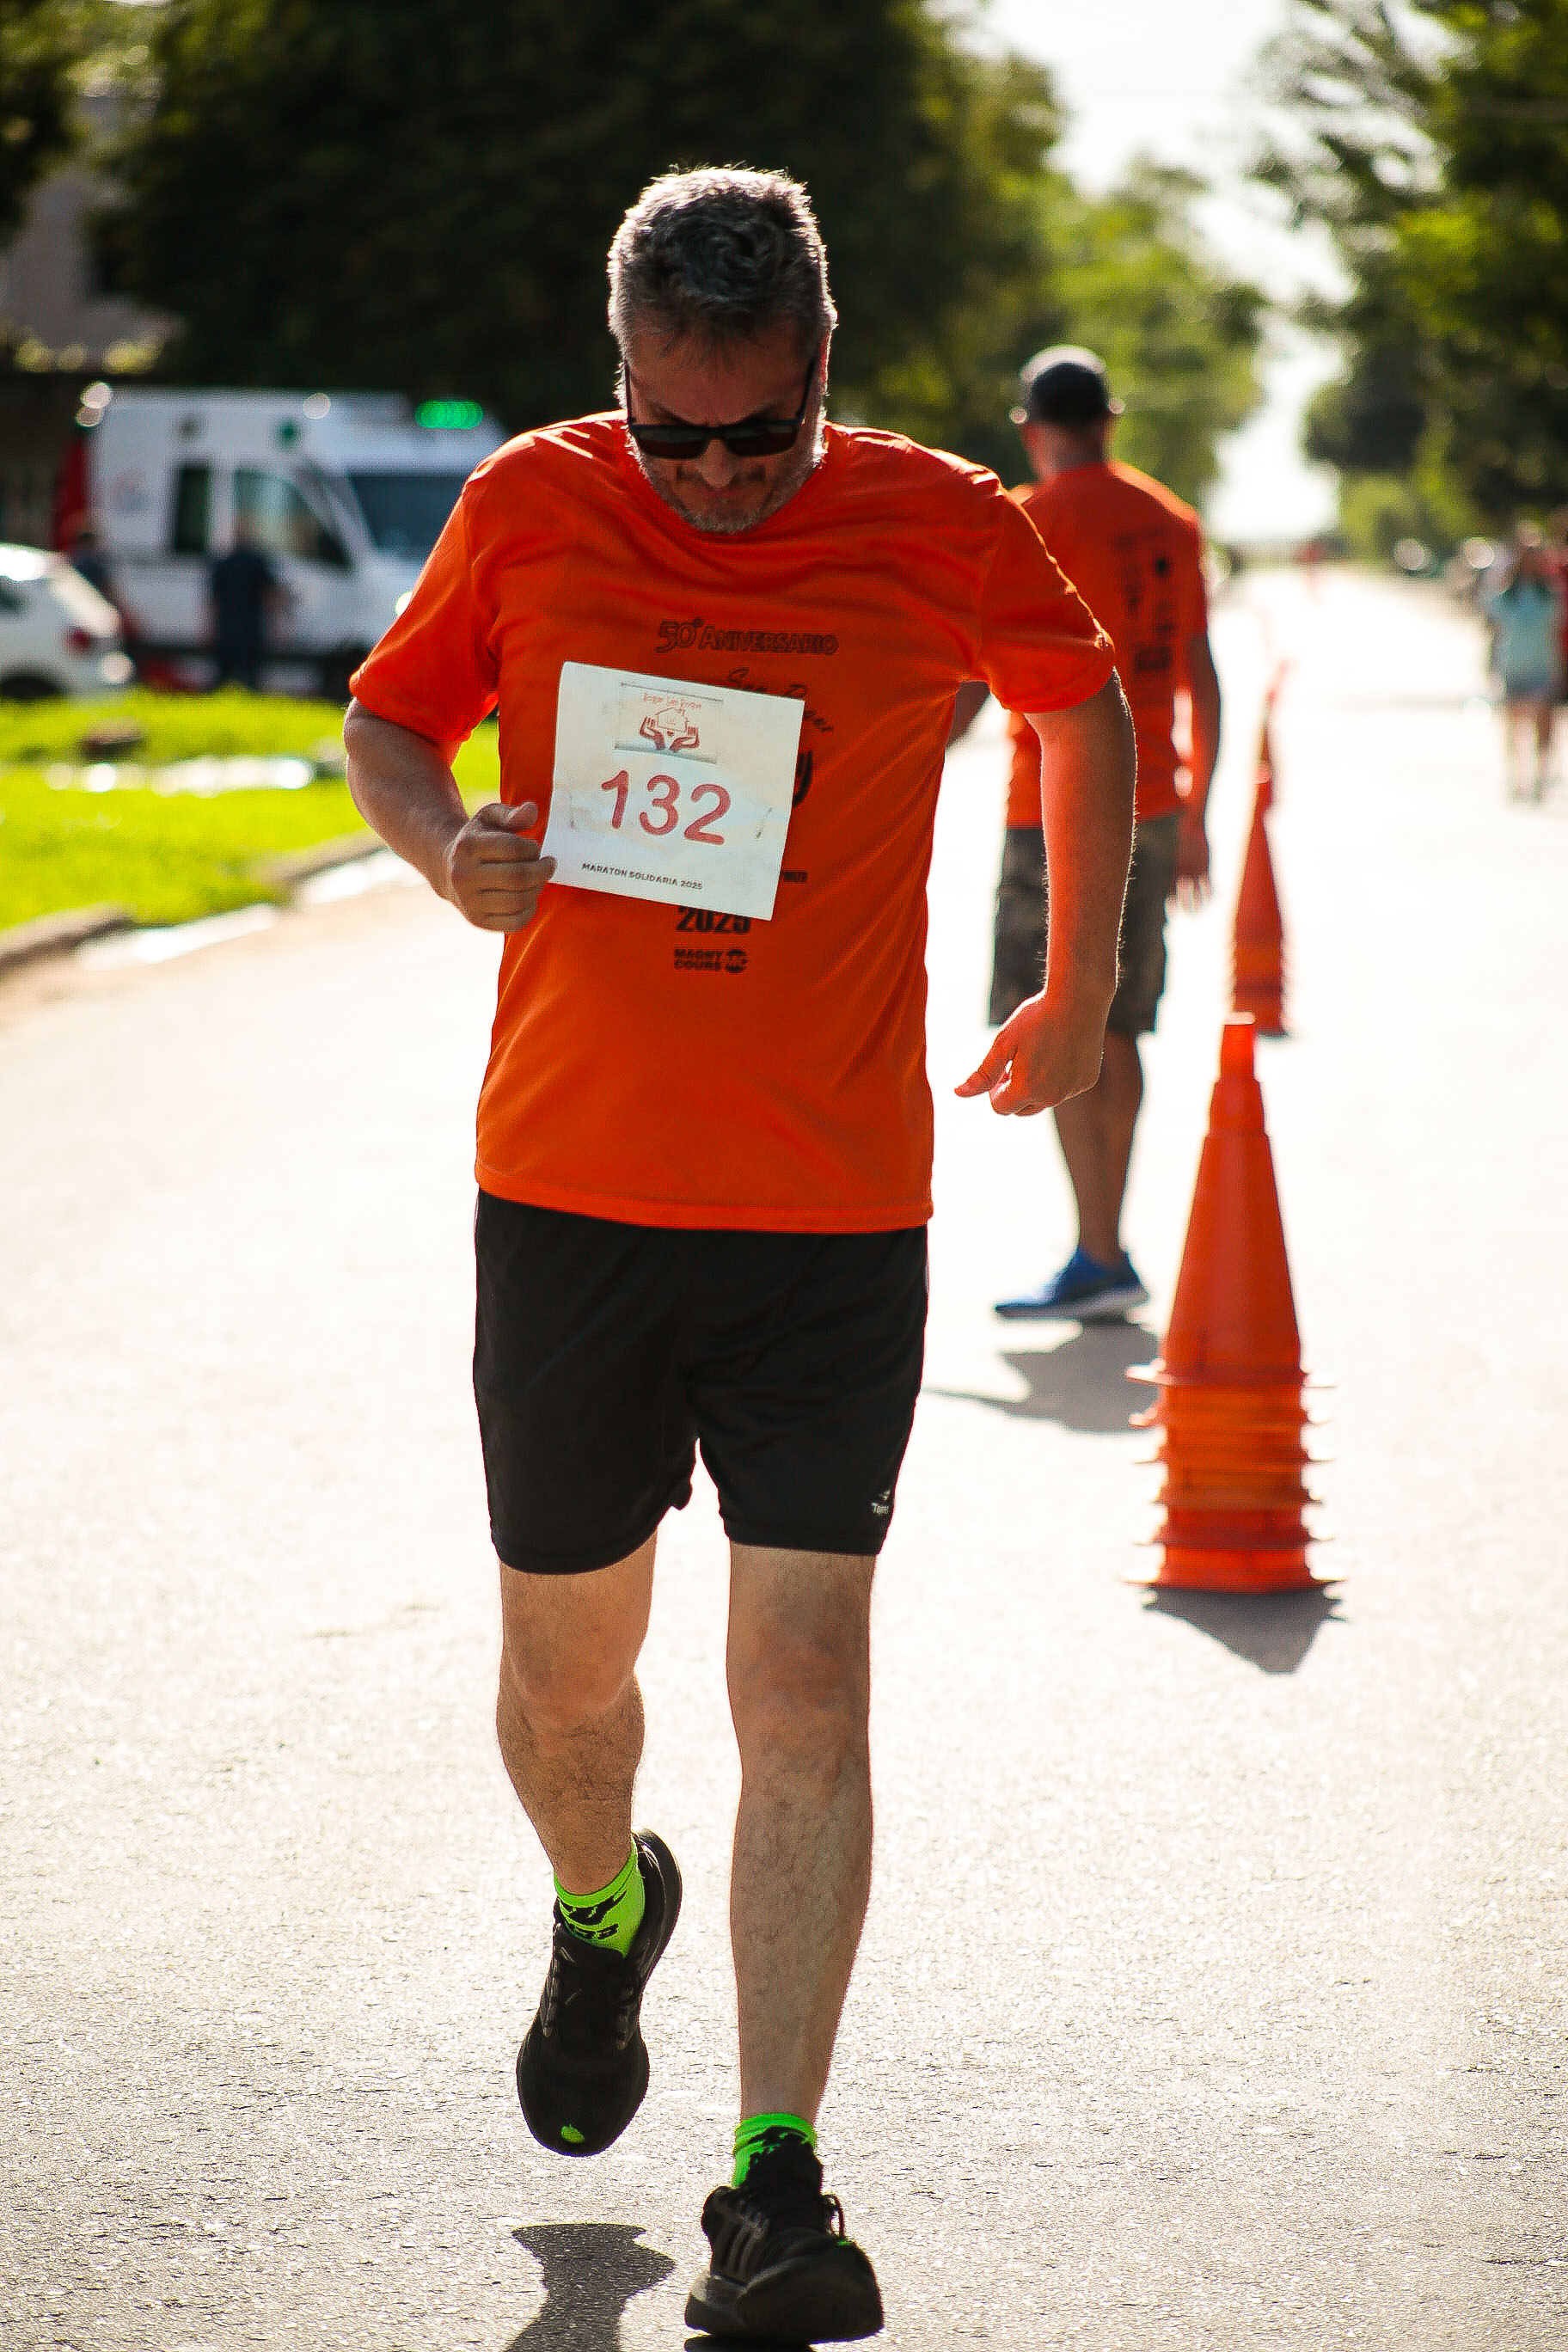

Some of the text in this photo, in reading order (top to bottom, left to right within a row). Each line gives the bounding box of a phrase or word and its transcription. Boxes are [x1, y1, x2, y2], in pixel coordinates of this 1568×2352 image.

[698, 624, 839, 654] ANIVERSARIO
[601, 769, 731, 845] 132
[582, 862, 703, 890] MARATON SOLIDARIA 2025
